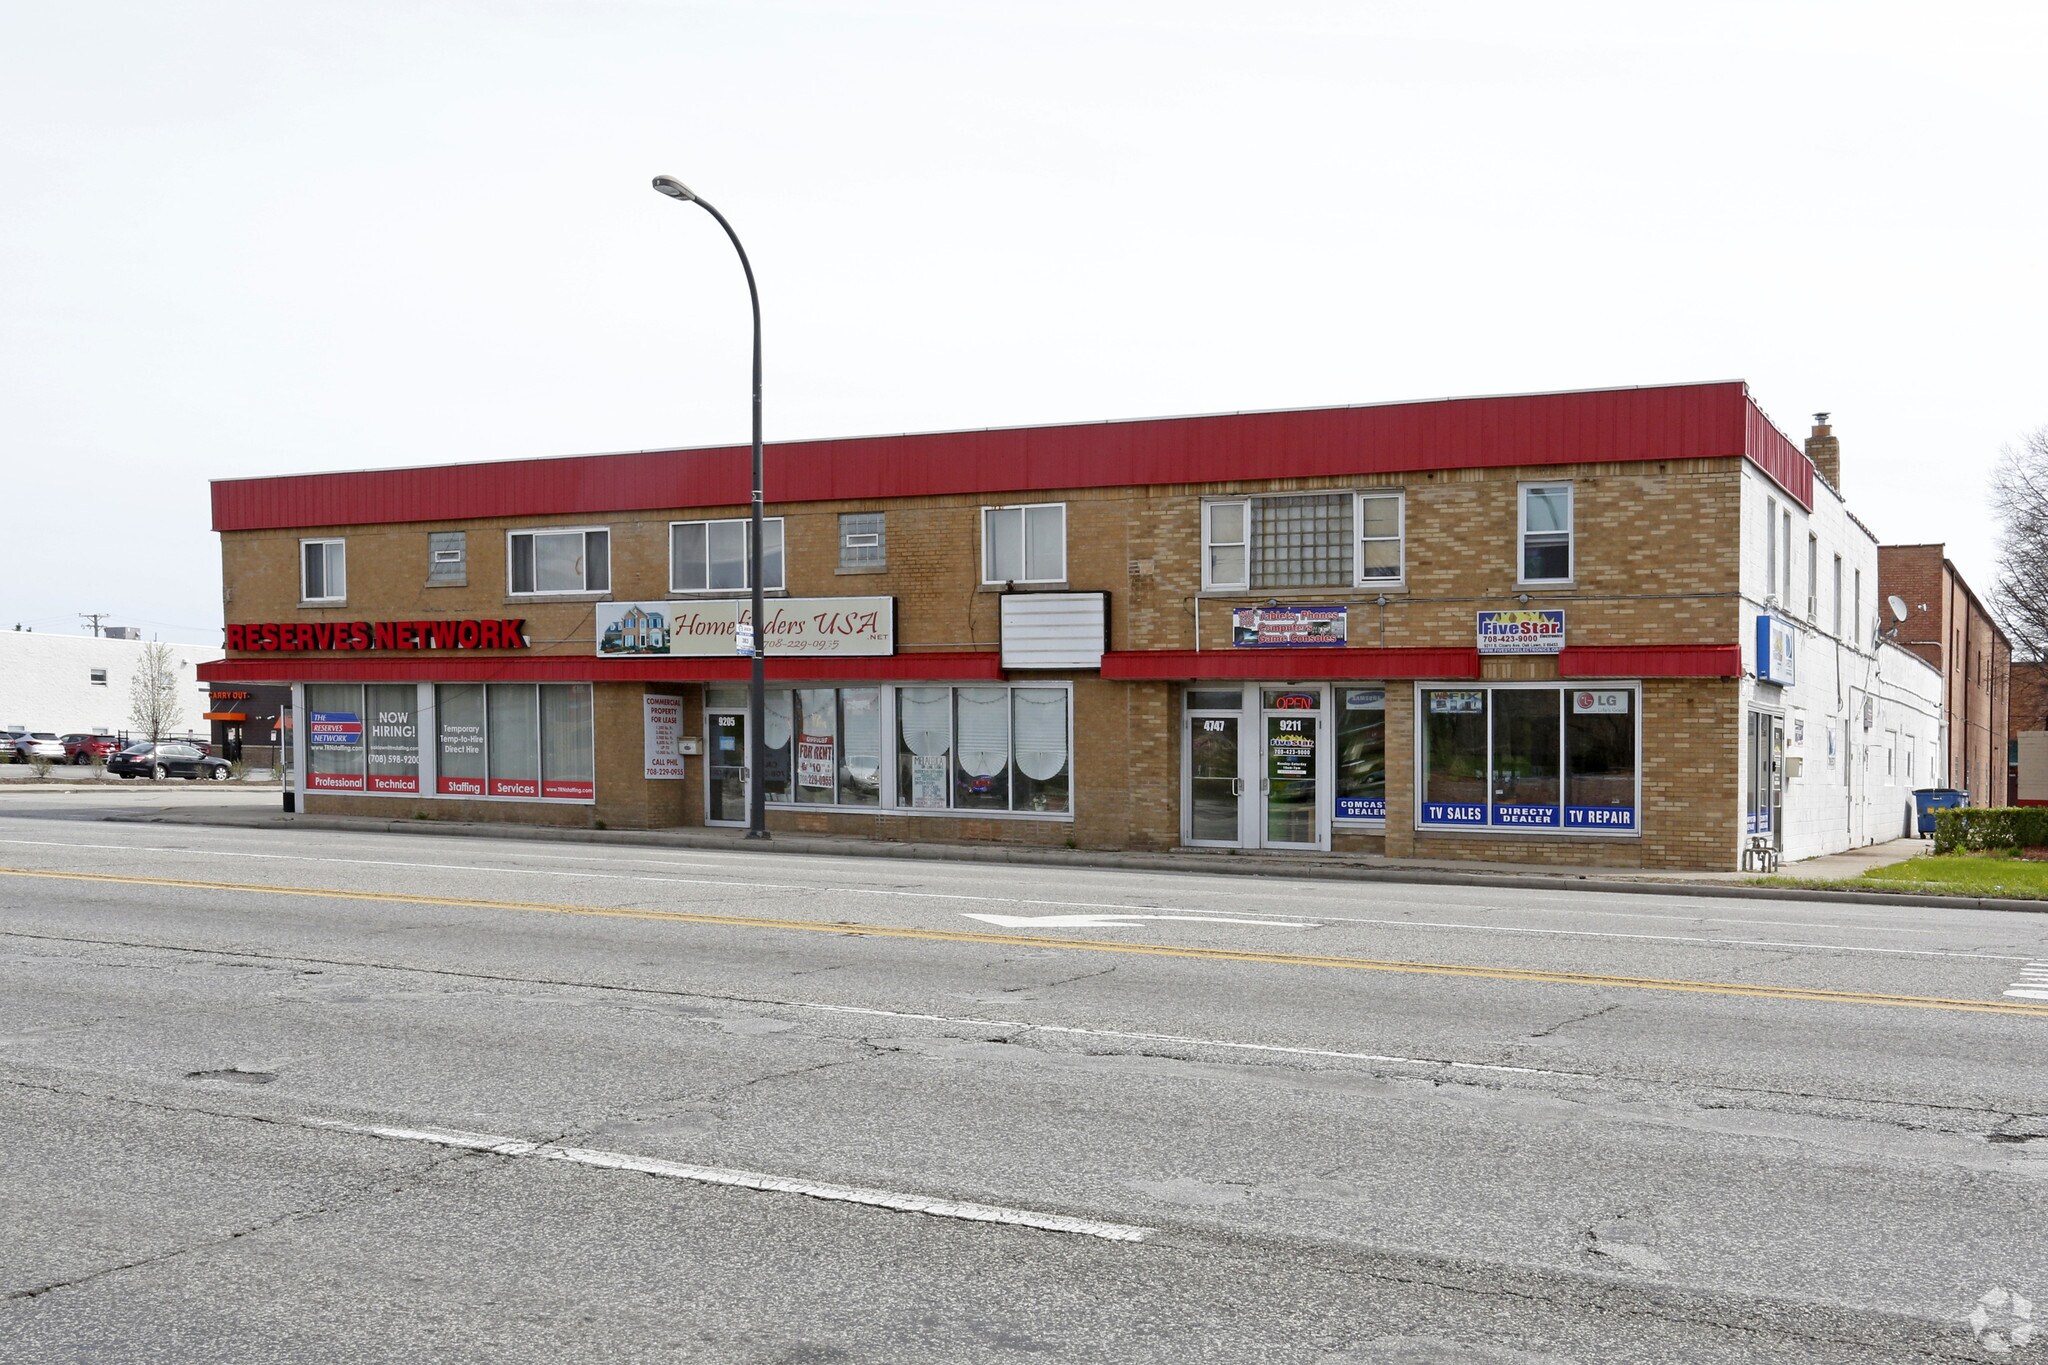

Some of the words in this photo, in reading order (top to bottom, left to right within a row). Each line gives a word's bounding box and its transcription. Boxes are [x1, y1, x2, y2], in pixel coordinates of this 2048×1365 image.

[1300, 610, 1339, 620] Phones
[674, 608, 806, 642] Homefders
[813, 611, 879, 636] USA
[1258, 623, 1313, 634] Computers
[1483, 621, 1559, 635] FiveStar
[227, 621, 370, 652] RESERVES
[374, 619, 523, 650] NETWORK
[1258, 634, 1288, 644] Game
[1289, 633, 1337, 643] Consoles
[1482, 635, 1538, 643] 708-423-9000
[208, 691, 232, 699] CARRY
[232, 691, 248, 699] OUT
[1597, 695, 1617, 706] LG
[646, 697, 681, 707] COMMERCIAL
[1276, 697, 1312, 710] OPEN
[651, 707, 677, 715] PROPERTY
[379, 712, 409, 723] NOW
[718, 716, 736, 727] 9205
[313, 724, 343, 732] RESERVES
[443, 724, 480, 734] Temporary
[1203, 720, 1225, 732] 4747
[1279, 719, 1302, 731] 9211
[372, 725, 416, 737] HIRING!
[313, 734, 348, 742] NETWORK
[440, 734, 484, 744] Temp-to-Hire
[1270, 738, 1314, 747] FiveStar
[444, 745, 465, 753] Direct
[466, 746, 480, 754] Hire
[799, 744, 813, 759] FOR
[813, 746, 832, 761] RENT
[368, 754, 387, 765] (708)
[388, 755, 420, 765] 598-9200
[651, 758, 665, 766] CALL
[646, 768, 684, 776] 708-229-0955
[315, 777, 363, 788] Professional
[374, 778, 416, 789] Technical
[448, 781, 481, 795] Staffing
[497, 782, 535, 794] Services
[1348, 808, 1386, 816] DEALER
[1429, 806, 1443, 819] TV
[1447, 807, 1482, 821] SALES
[1499, 807, 1553, 816] DIRECTV
[1569, 810, 1584, 823] TV
[1588, 810, 1631, 824] REPAIR
[1503, 815, 1551, 824] DEALER
